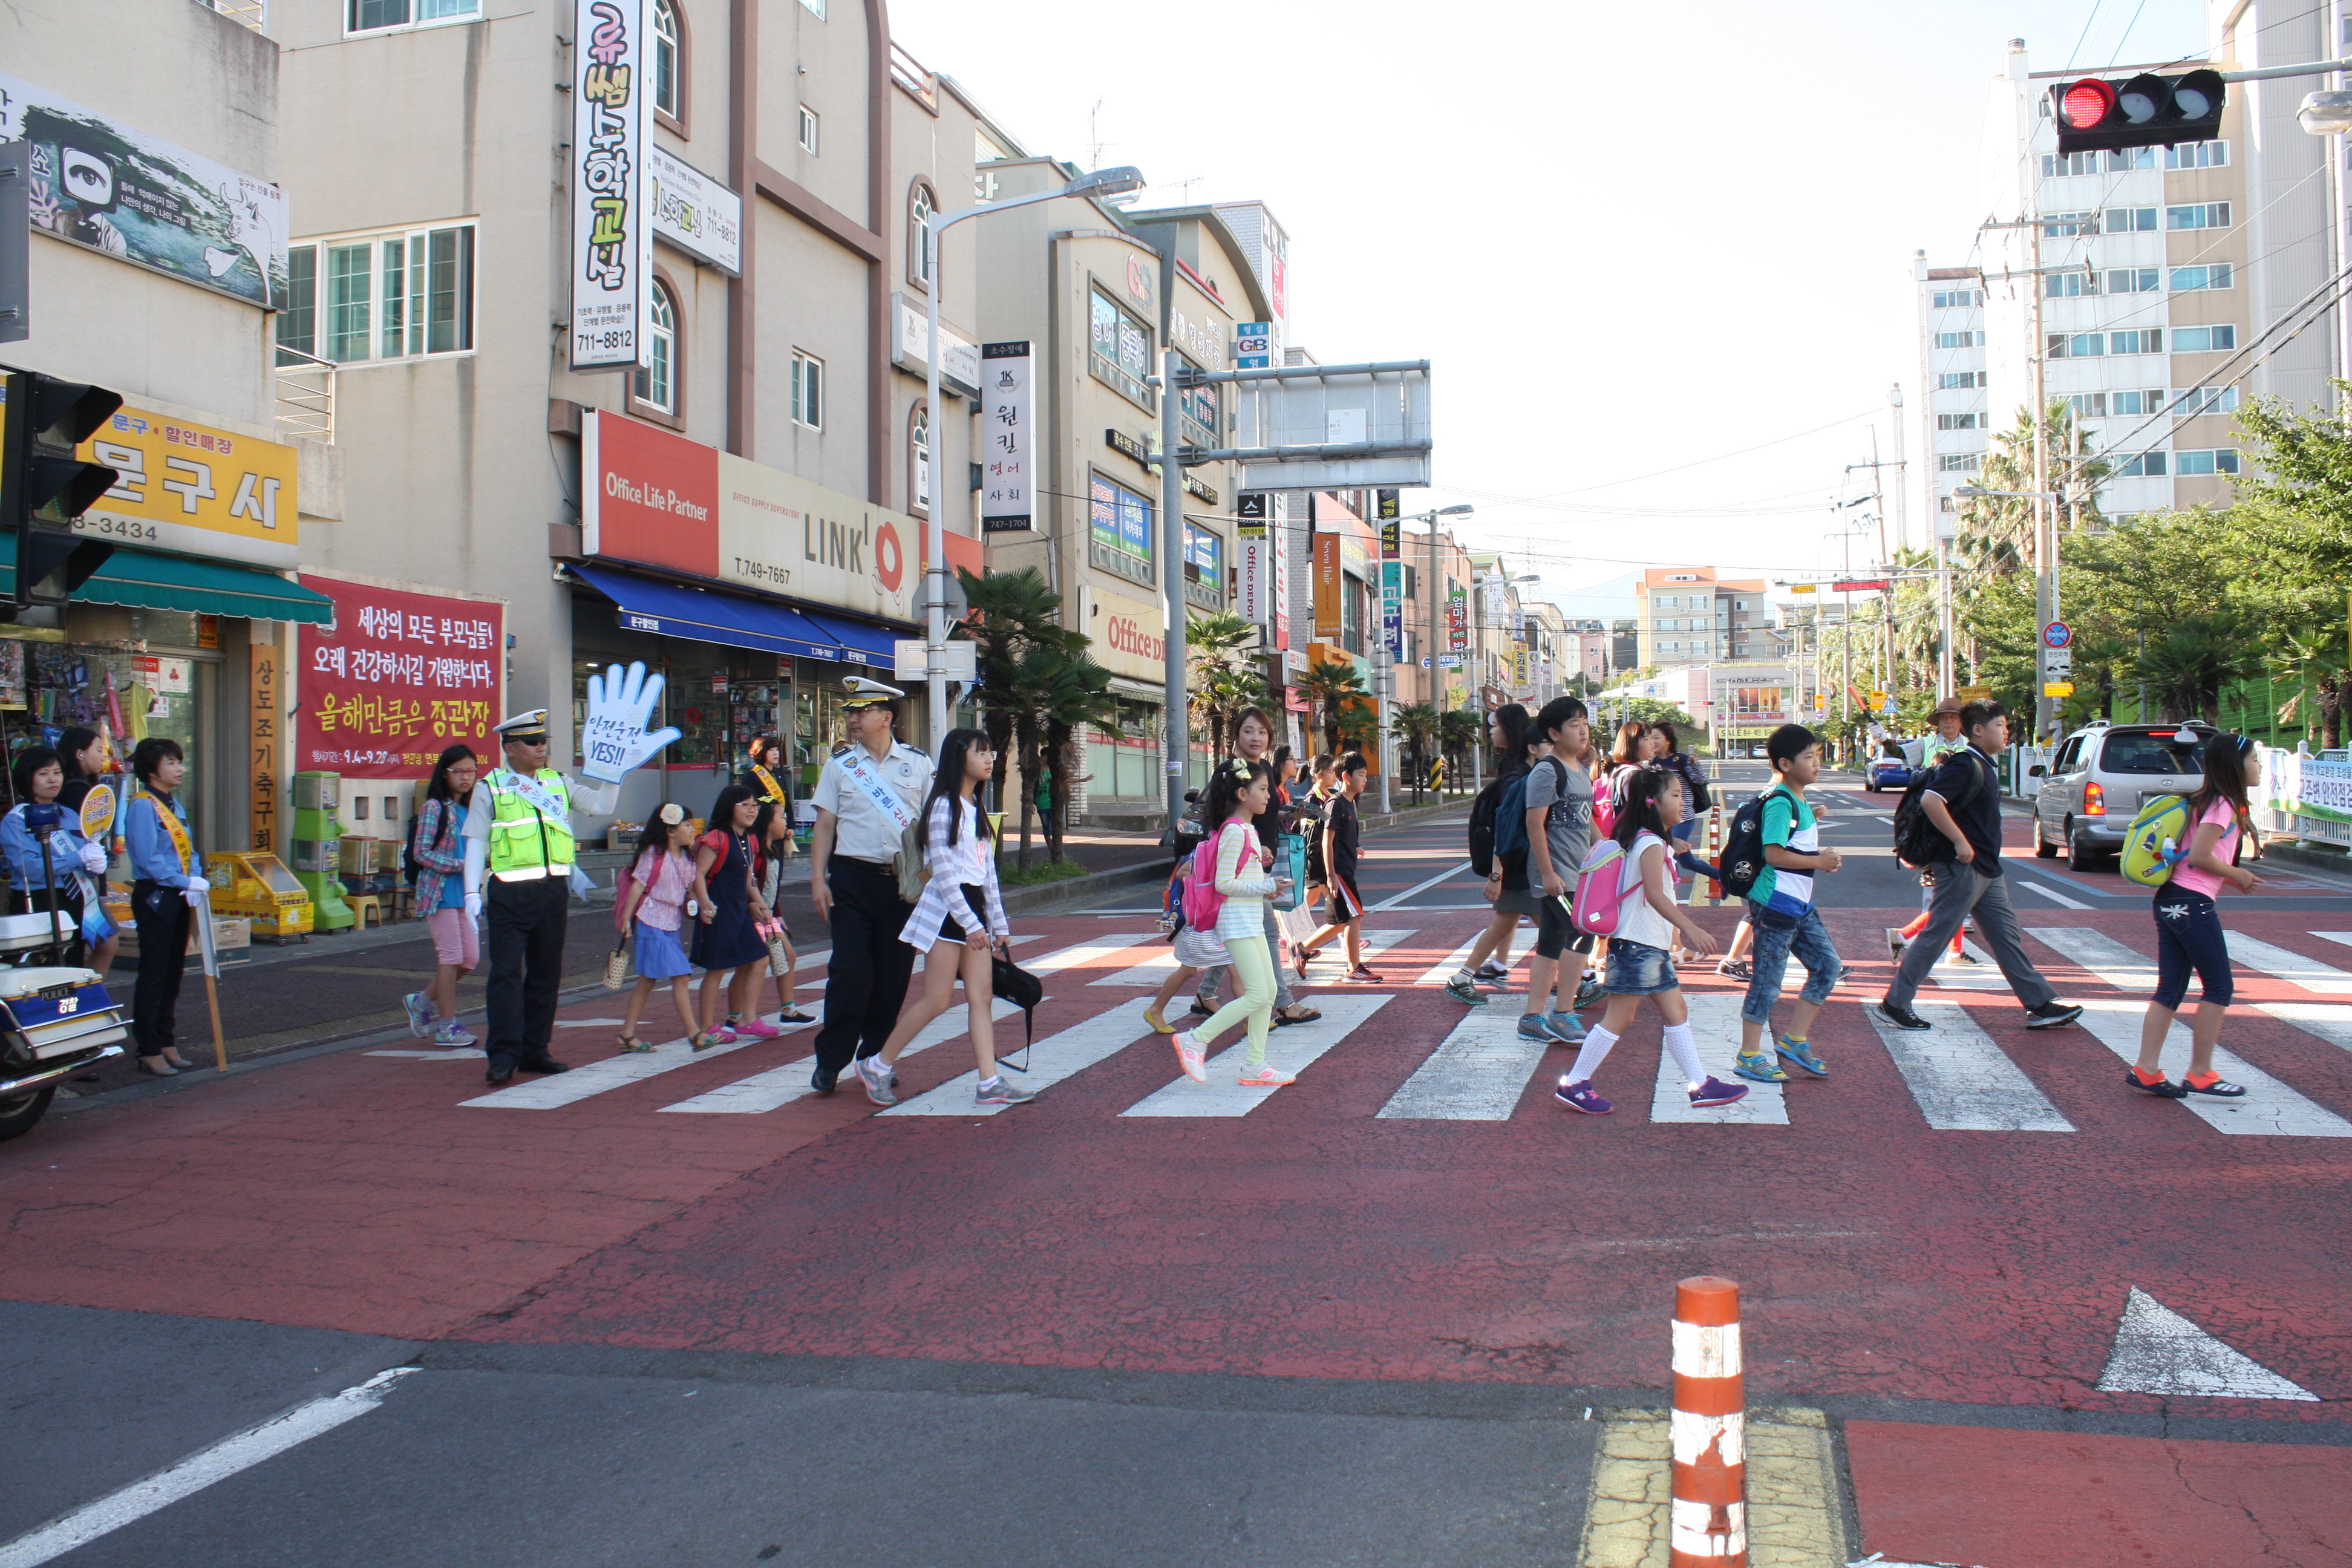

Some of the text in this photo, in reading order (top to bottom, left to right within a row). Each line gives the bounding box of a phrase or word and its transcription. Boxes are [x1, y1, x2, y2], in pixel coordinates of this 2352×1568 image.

[238, 177, 256, 191] 입구는
[258, 185, 268, 197] 건물
[121, 195, 141, 210] 나만의
[159, 209, 172, 221] 나의
[173, 215, 186, 227] 그림
[166, 199, 179, 211] 않는
[707, 217, 736, 246] 711-8812
[1093, 301, 1114, 351] 영어
[578, 330, 632, 351] 711-8812
[990, 345, 1023, 354] 소수정예
[1122, 324, 1146, 375] 중국어
[1239, 339, 1267, 352] GnB
[952, 344, 977, 365] Academy
[111, 413, 234, 456] 문구 할인매장
[990, 462, 1019, 475] 영어
[606, 471, 708, 521] Office Life Partner
[733, 492, 800, 520] OFFICE SUPPLY SUPERSTORE
[990, 489, 1019, 501] 사회
[990, 520, 1027, 528] 747-1704
[734, 557, 791, 585] T.749-7667
[1247, 546, 1256, 580] Office
[1323, 540, 1332, 584] Seven Hair
[631, 616, 659, 630] 문구할인점
[1452, 595, 1464, 627] 엄마가
[358, 606, 494, 650] 세상의 모든 부모님들!
[1108, 615, 1151, 658] Office
[811, 647, 834, 659] T.749-7667
[848, 651, 866, 663] 문구할인점
[313, 646, 494, 689] 오래 건강하시길 기원합니다.
[1517, 652, 1526, 681] 논리속독
[315, 692, 489, 739] 올해만큼은 정관장
[589, 715, 642, 745] 안전운전
[1721, 728, 1742, 737] SALE
[255, 660, 274, 851] 상도조기축구회
[402, 753, 422, 765] 정관장
[590, 740, 626, 766] YES!!
[2315, 765, 2334, 778] 학교환경
[2336, 766, 2351, 779] 조성을
[87, 792, 110, 812] 정지선을
[872, 786, 895, 810] 바른
[42, 987, 70, 1001] POLICE
[59, 996, 79, 1014] 경찰
